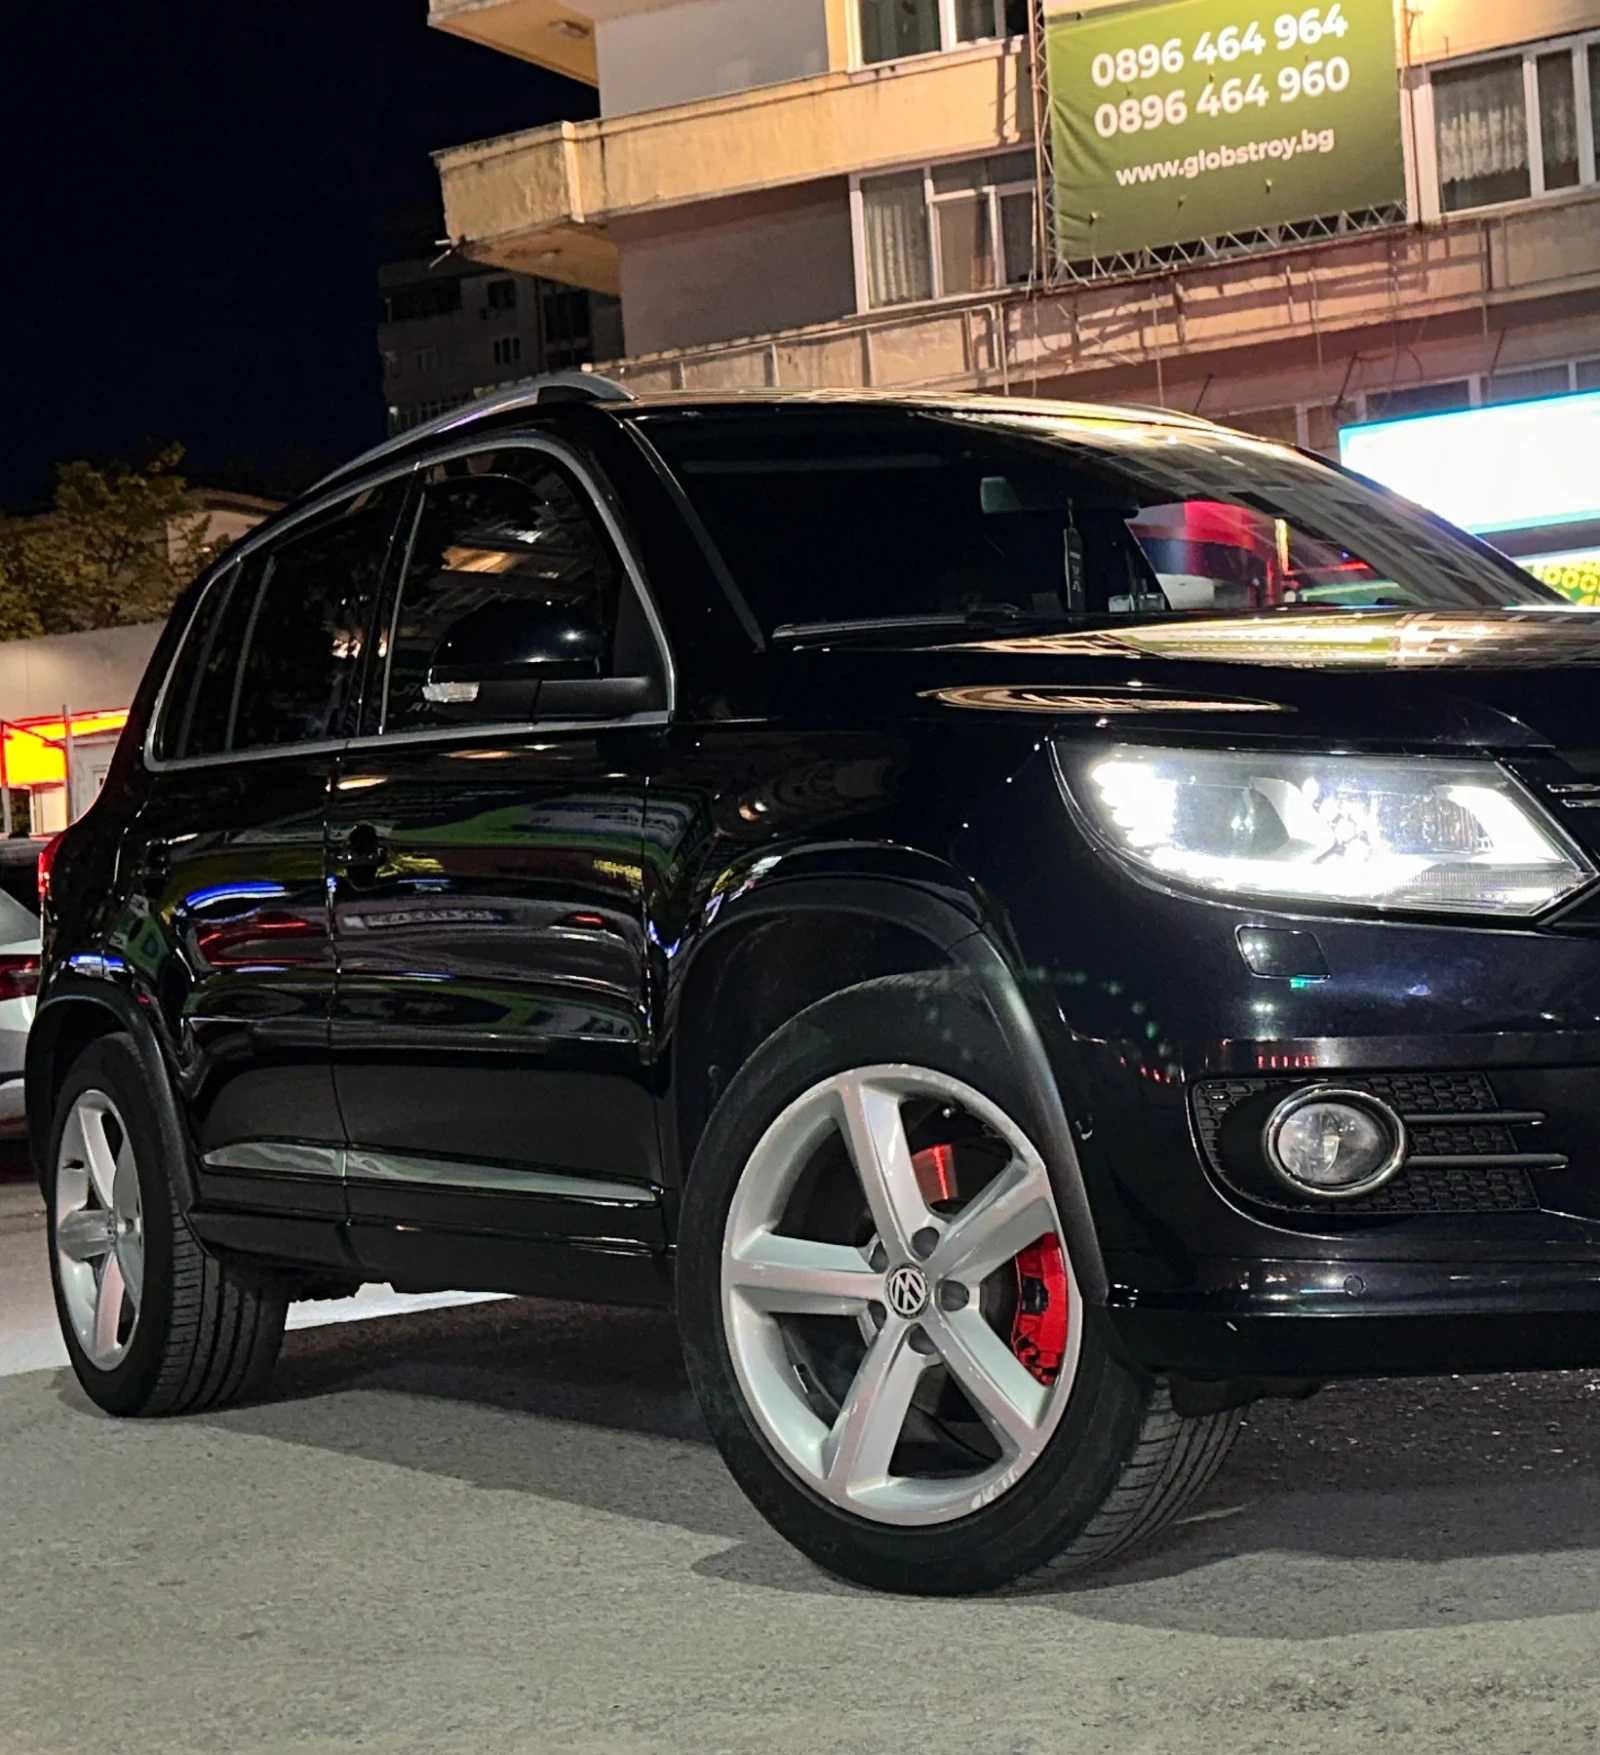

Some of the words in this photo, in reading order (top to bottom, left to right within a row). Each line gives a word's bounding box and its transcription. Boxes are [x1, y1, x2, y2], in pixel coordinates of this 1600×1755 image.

[1091, 38, 1185, 88] 0896
[1192, 21, 1266, 66] 464
[1273, 3, 1349, 51] 964
[1094, 89, 1188, 139] 0896
[1195, 73, 1270, 118] 464
[1278, 55, 1350, 103] 960
[1115, 126, 1335, 187] www.globstroy.bg
